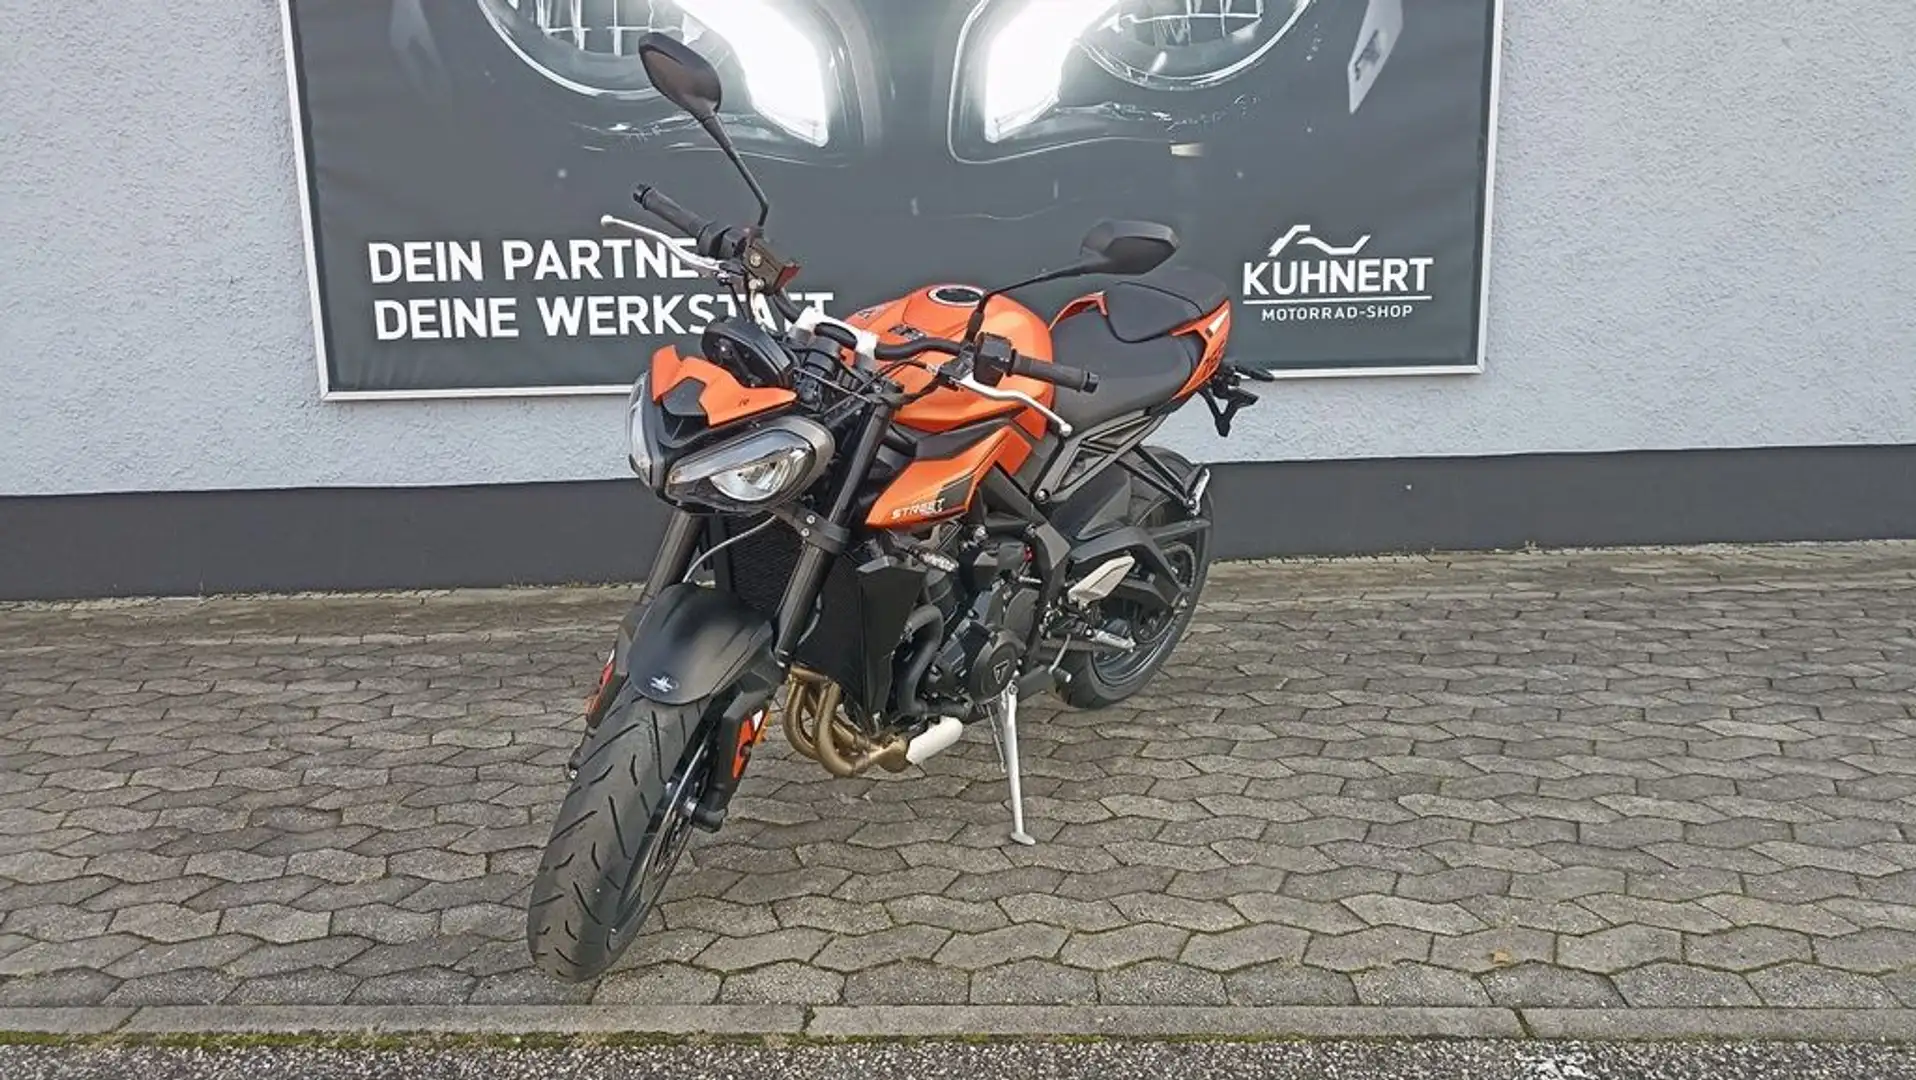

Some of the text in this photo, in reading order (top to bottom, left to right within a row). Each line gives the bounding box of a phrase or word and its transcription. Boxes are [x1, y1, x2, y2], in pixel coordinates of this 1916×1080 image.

[368, 236, 700, 283] DEIN PARTNE
[1243, 257, 1434, 295] KUHNERT
[374, 298, 519, 340] DEINE
[1261, 305, 1413, 321] MOTORRAD-SHOP
